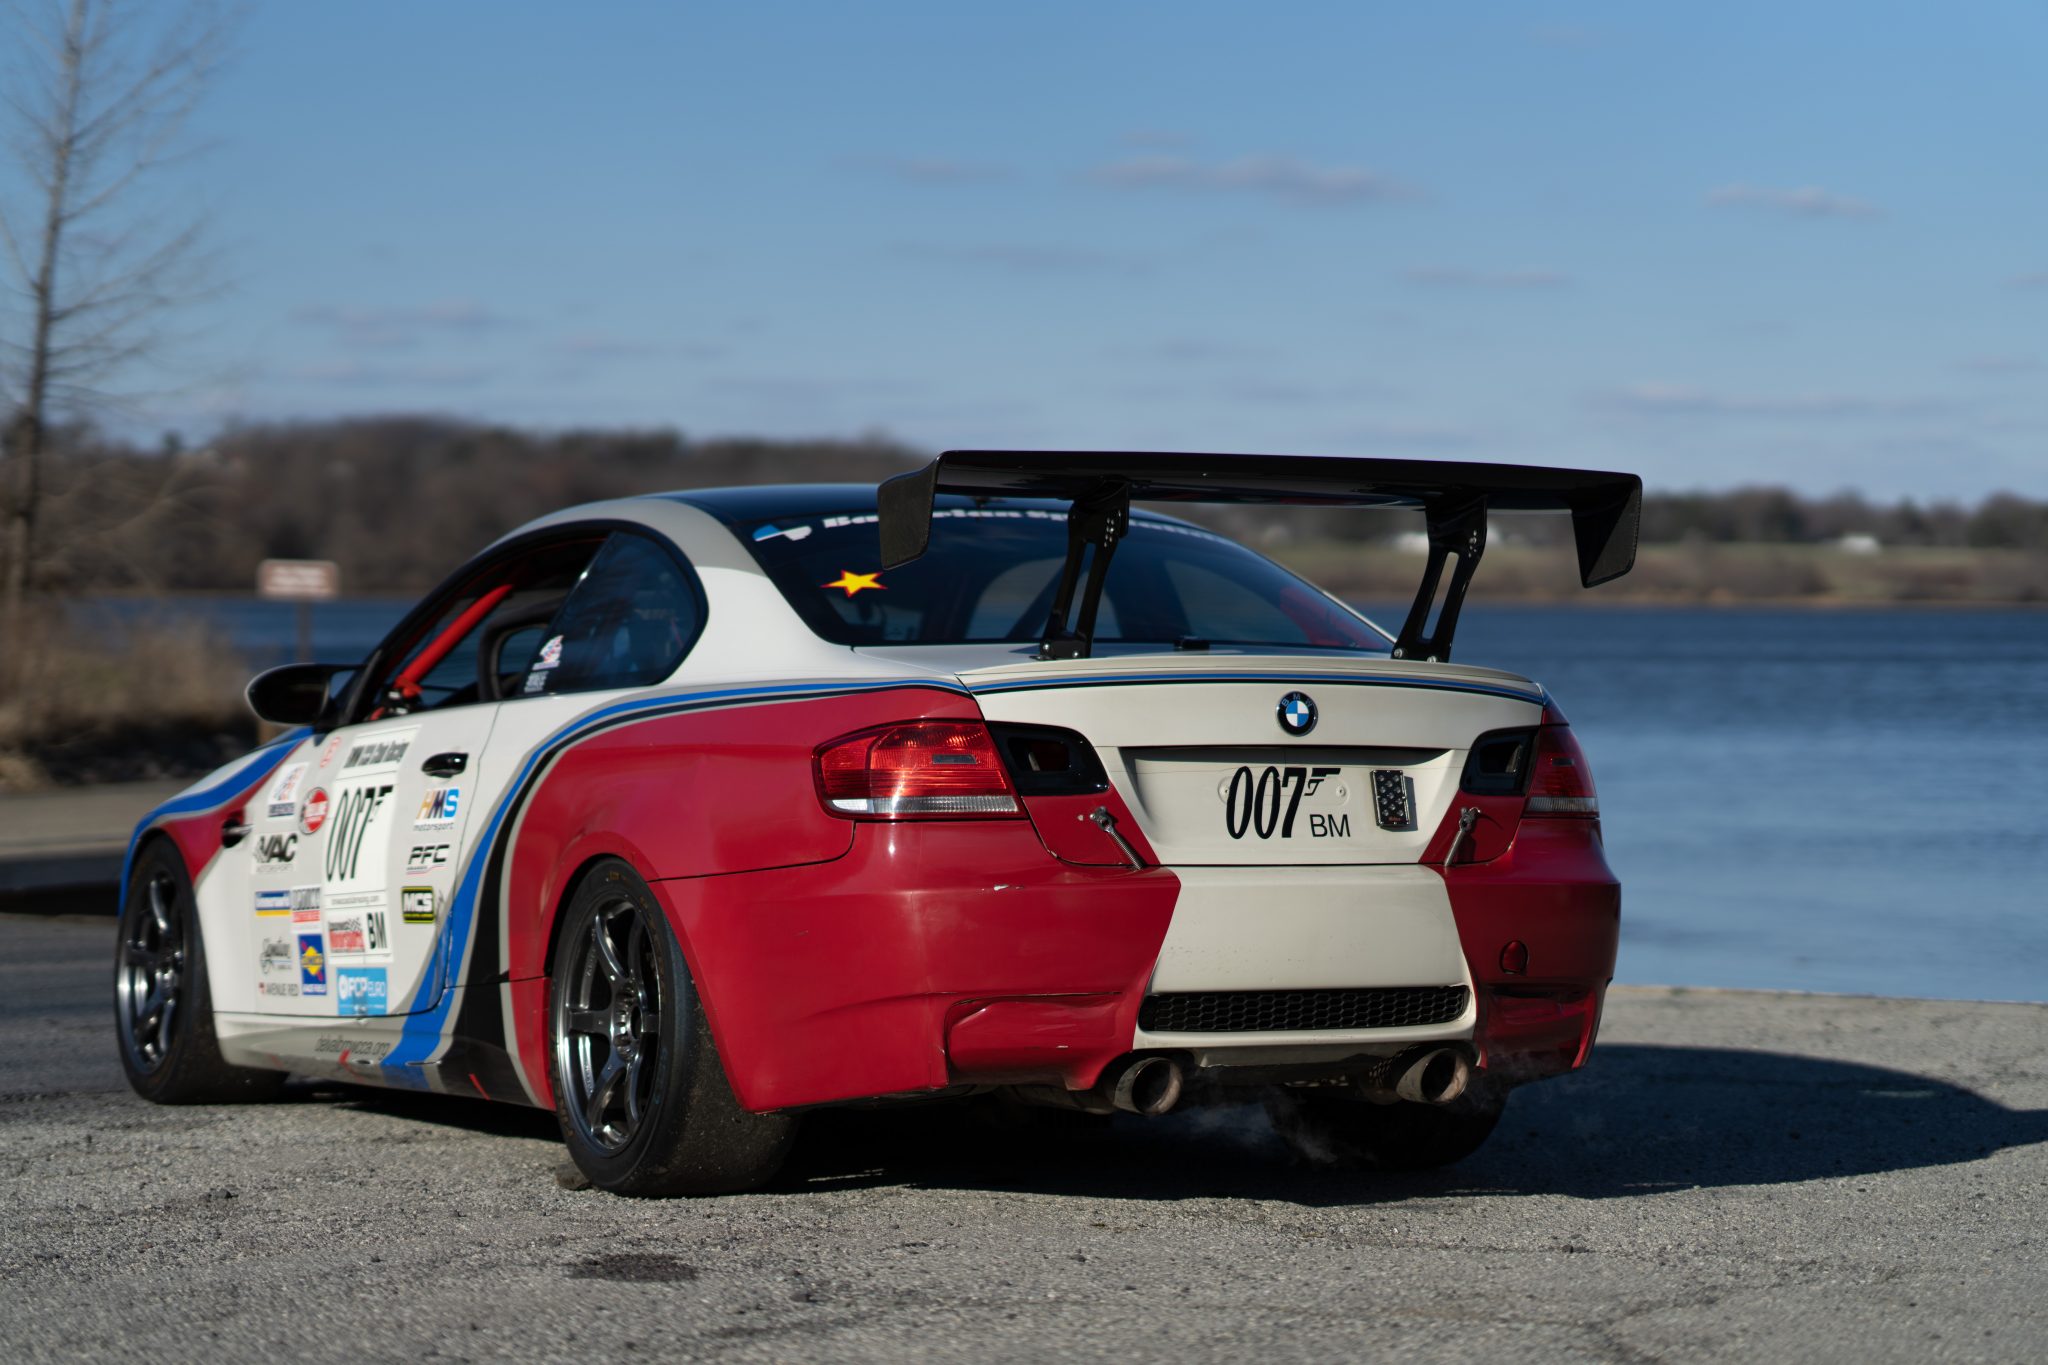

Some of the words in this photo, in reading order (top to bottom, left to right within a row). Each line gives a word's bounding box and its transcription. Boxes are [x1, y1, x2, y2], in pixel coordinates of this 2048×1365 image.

[1281, 693, 1315, 708] BMW
[416, 789, 460, 819] HMS
[1226, 766, 1307, 839] 007
[327, 786, 376, 882] 007
[1310, 814, 1351, 837] BM
[256, 833, 298, 863] VAC
[409, 844, 450, 865] PFC
[403, 892, 434, 913] MCS
[367, 912, 388, 949] BM
